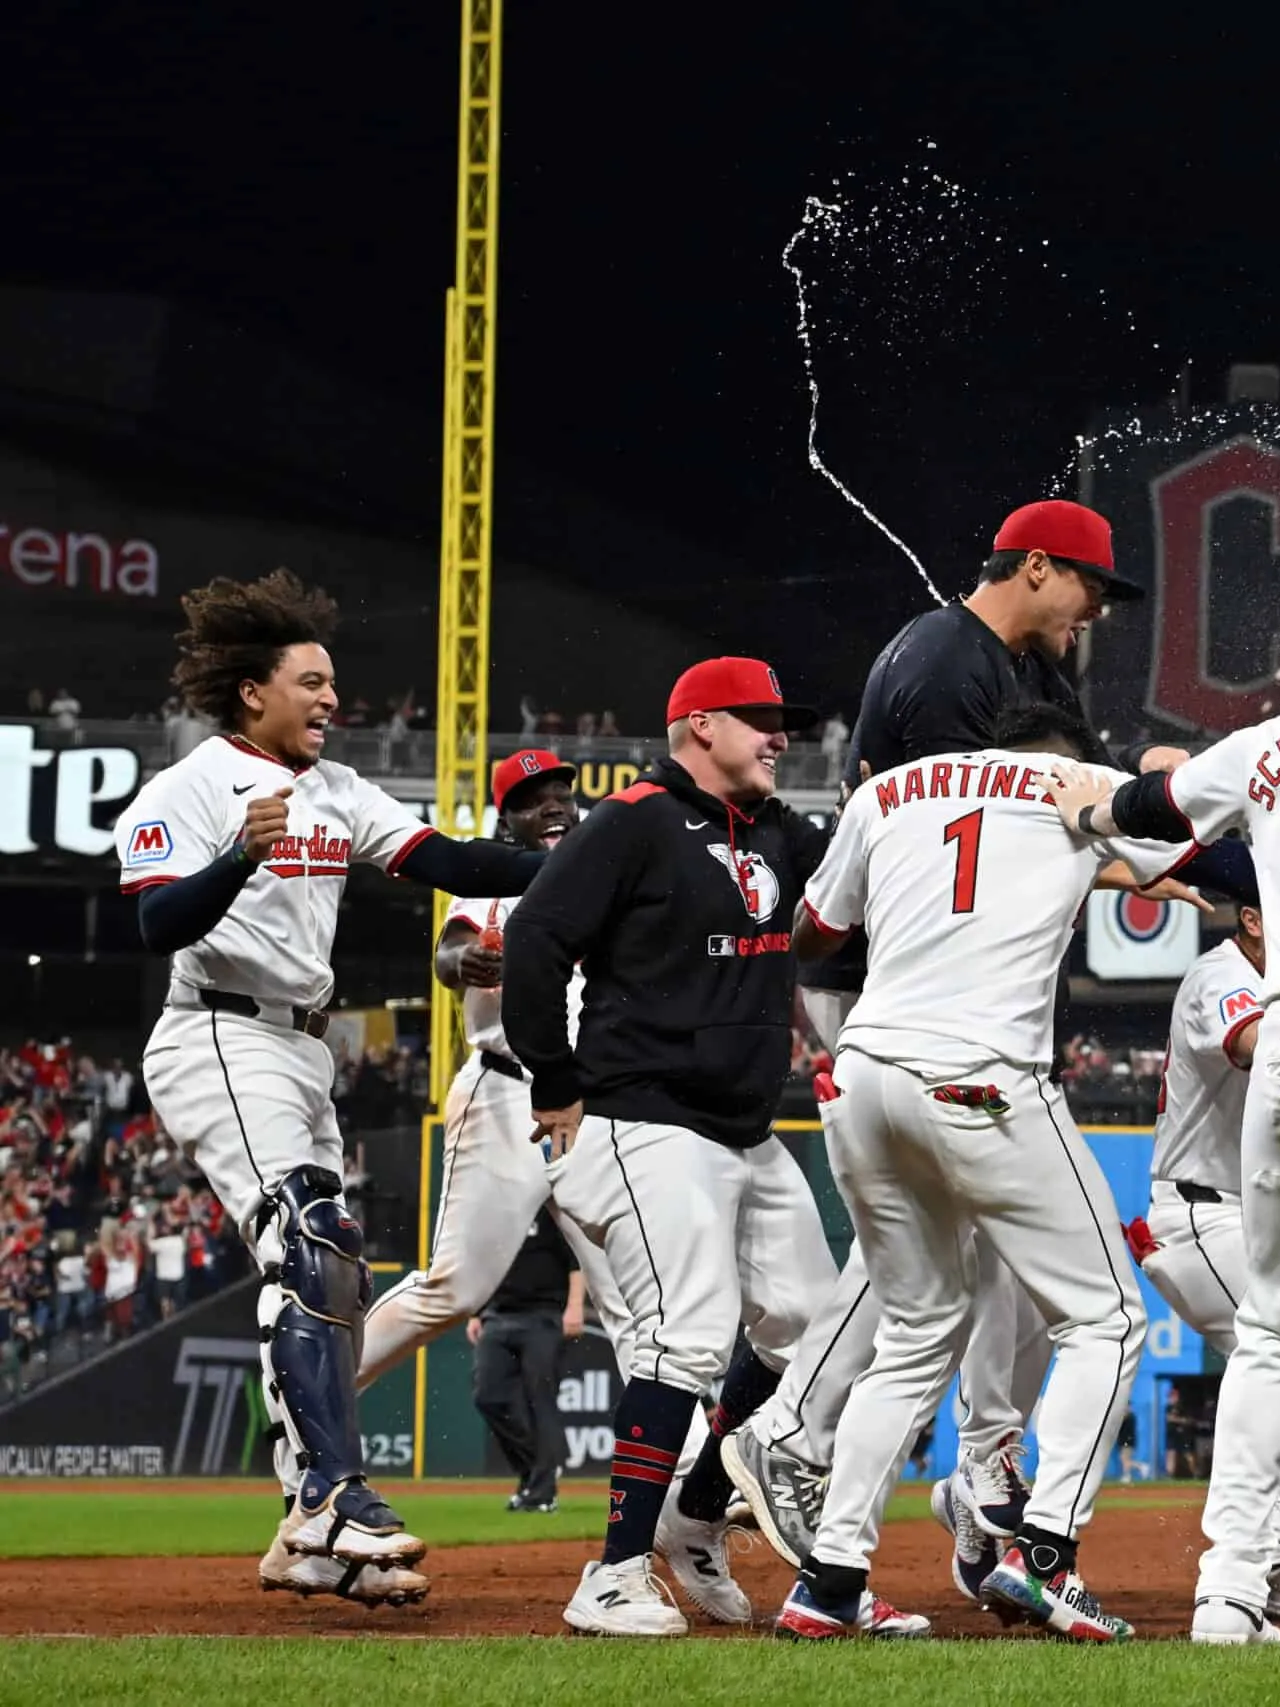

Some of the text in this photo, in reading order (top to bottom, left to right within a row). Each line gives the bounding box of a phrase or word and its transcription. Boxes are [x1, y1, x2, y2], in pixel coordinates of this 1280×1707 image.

[0, 522, 158, 597] ena
[519, 753, 541, 775] C
[133, 826, 164, 852] M
[271, 824, 352, 863] uardian
[943, 806, 984, 914] 1
[1225, 992, 1258, 1018] M
[556, 1370, 610, 1412] all
[55, 1444, 107, 1476] PEOPLE
[109, 1445, 164, 1476] MATTER
[359, 1433, 413, 1467] 25
